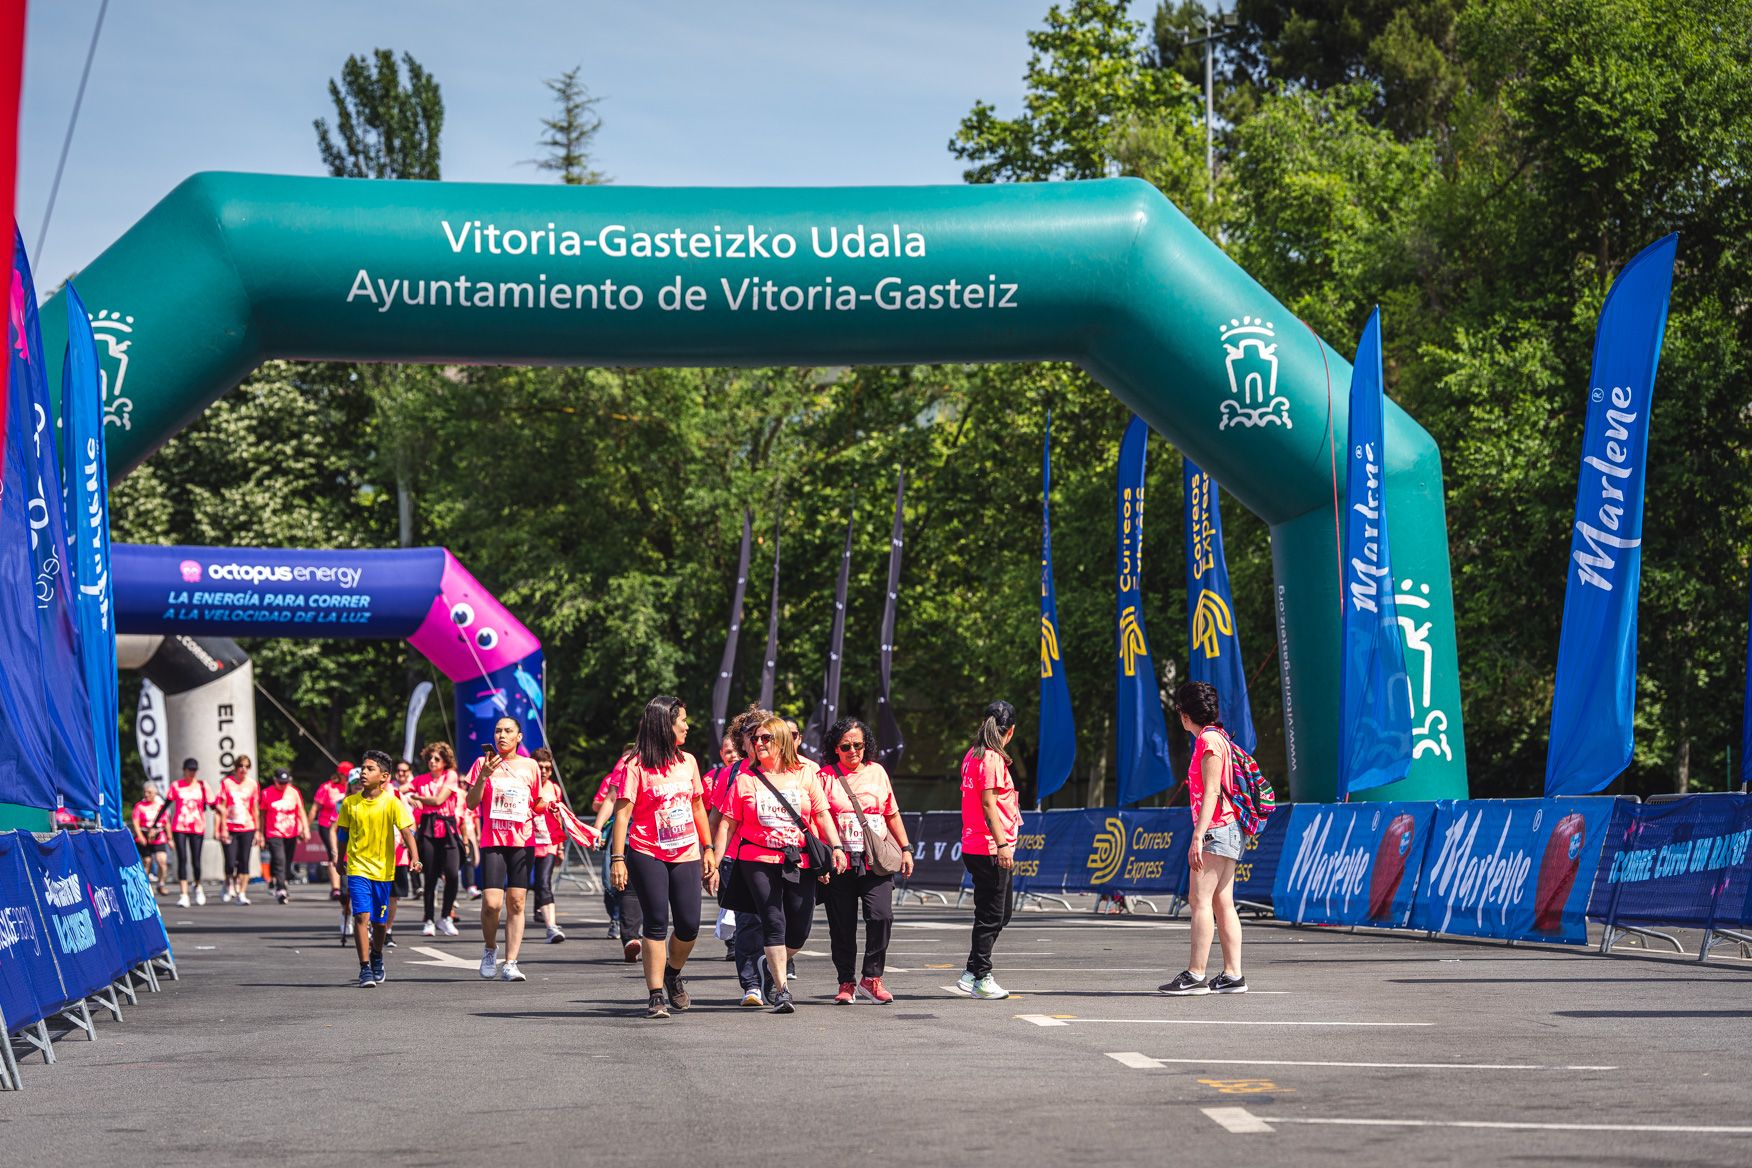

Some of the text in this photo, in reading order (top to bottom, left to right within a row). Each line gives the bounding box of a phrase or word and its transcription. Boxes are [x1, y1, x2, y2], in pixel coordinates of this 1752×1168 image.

[441, 220, 927, 258] Vitoria-Gasteizko Udala
[346, 269, 1018, 312] Ayuntamiento de Vitoria-Gasteiz
[168, 590, 371, 609] LA ENERGÍA PARA CORRER
[178, 608, 199, 620] LA
[204, 609, 292, 622] VELOCIDAD
[294, 611, 314, 623] DE
[317, 611, 337, 623] LA
[340, 611, 372, 623] LUZ
[1278, 585, 1297, 771] www.vitoria-gasteiz.org
[218, 703, 234, 732] EL
[1015, 833, 1046, 849] orreos
[1132, 827, 1174, 850] Correos
[1124, 856, 1163, 884] Express
